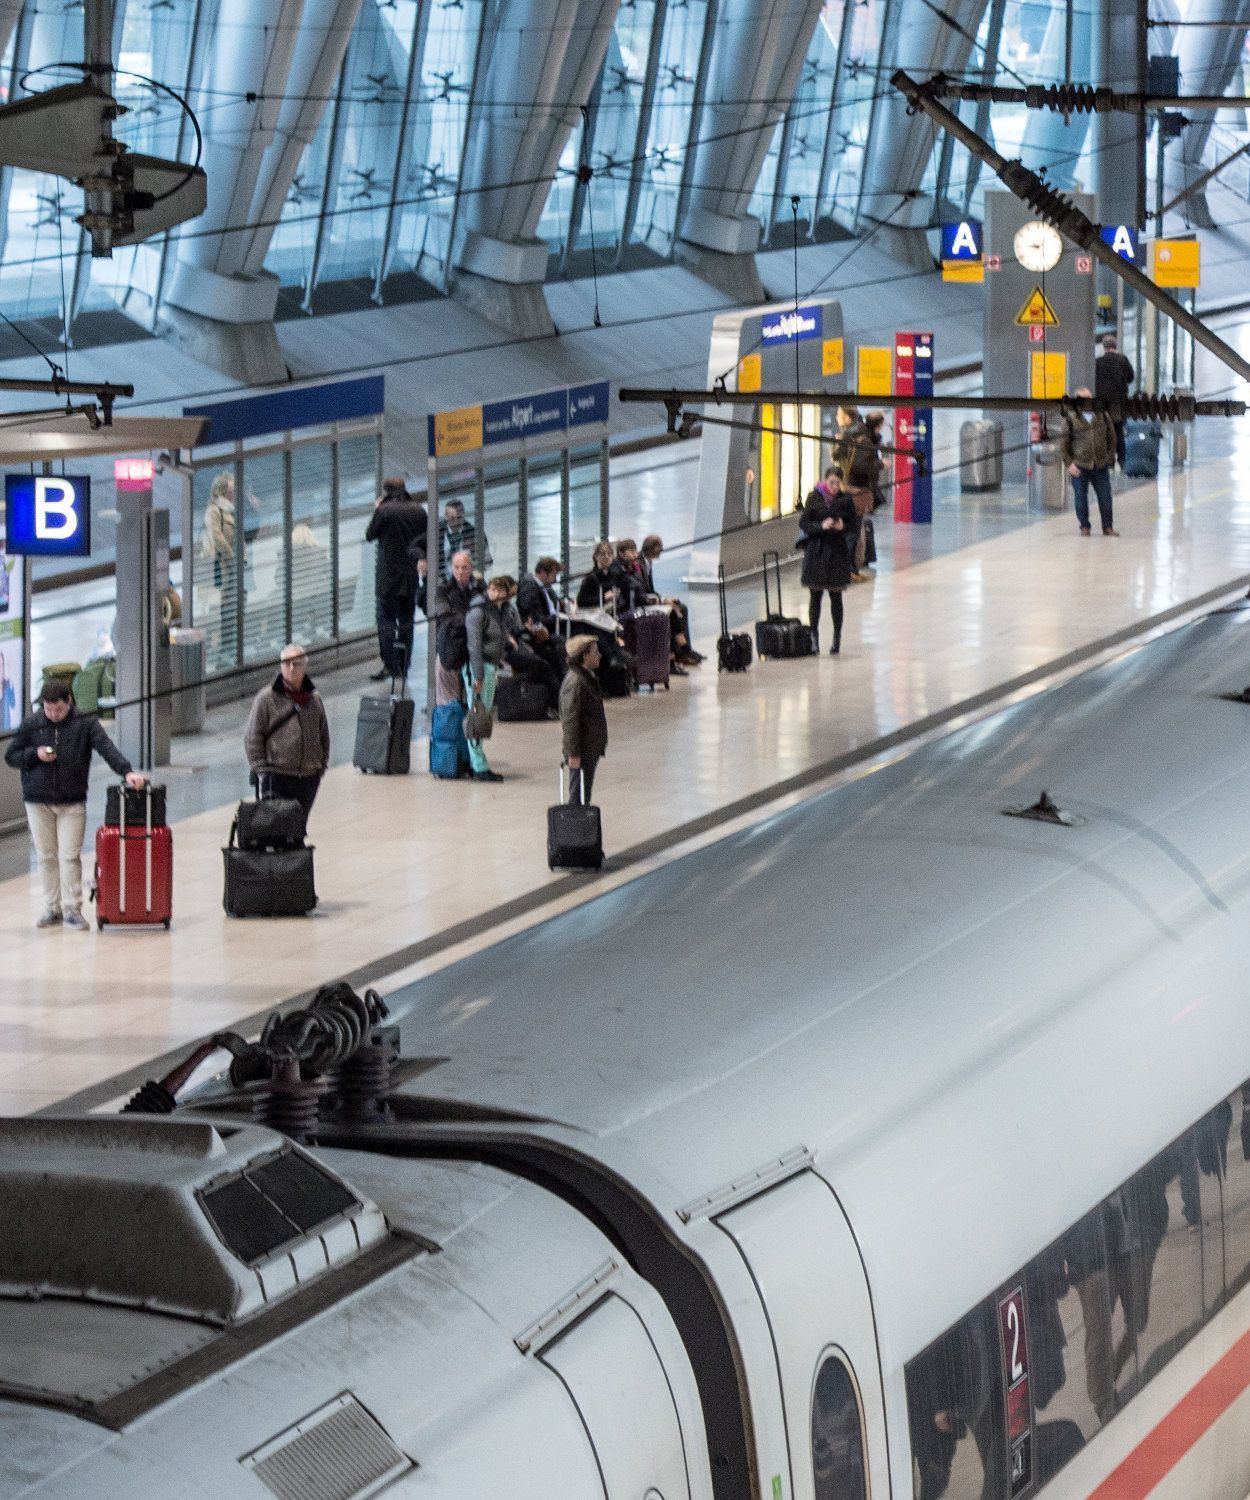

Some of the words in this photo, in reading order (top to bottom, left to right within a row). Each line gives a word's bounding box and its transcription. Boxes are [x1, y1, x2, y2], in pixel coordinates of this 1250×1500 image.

[952, 222, 978, 255] A
[1113, 225, 1135, 259] A
[35, 477, 78, 540] B
[1008, 1300, 1023, 1382] 2
